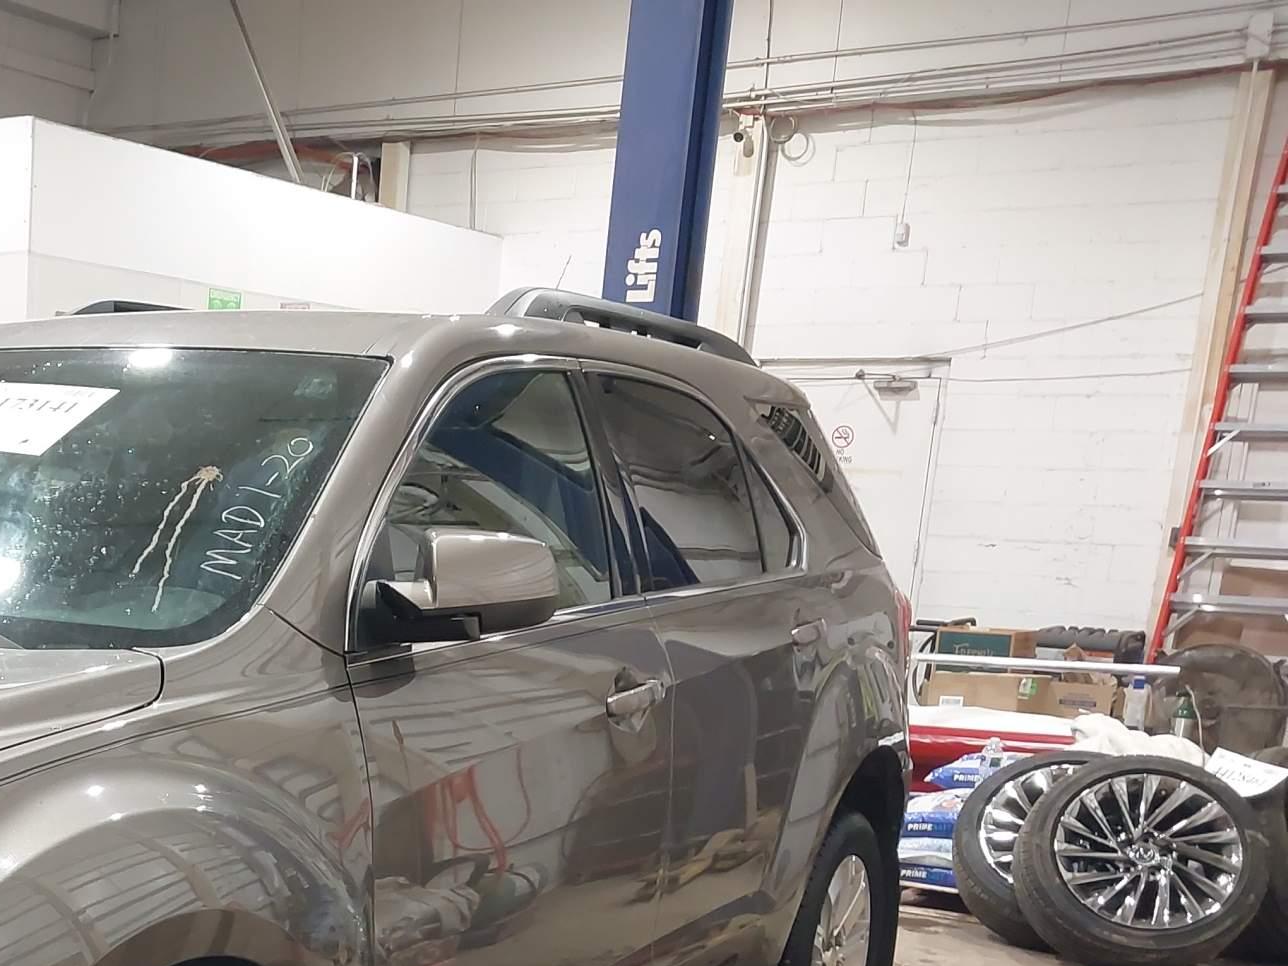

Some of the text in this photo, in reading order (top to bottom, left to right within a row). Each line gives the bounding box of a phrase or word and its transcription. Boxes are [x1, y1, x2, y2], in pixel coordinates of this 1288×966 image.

[625, 229, 662, 303] Lifts
[200, 505, 265, 580] MAD
[900, 868, 928, 879] PRIME
